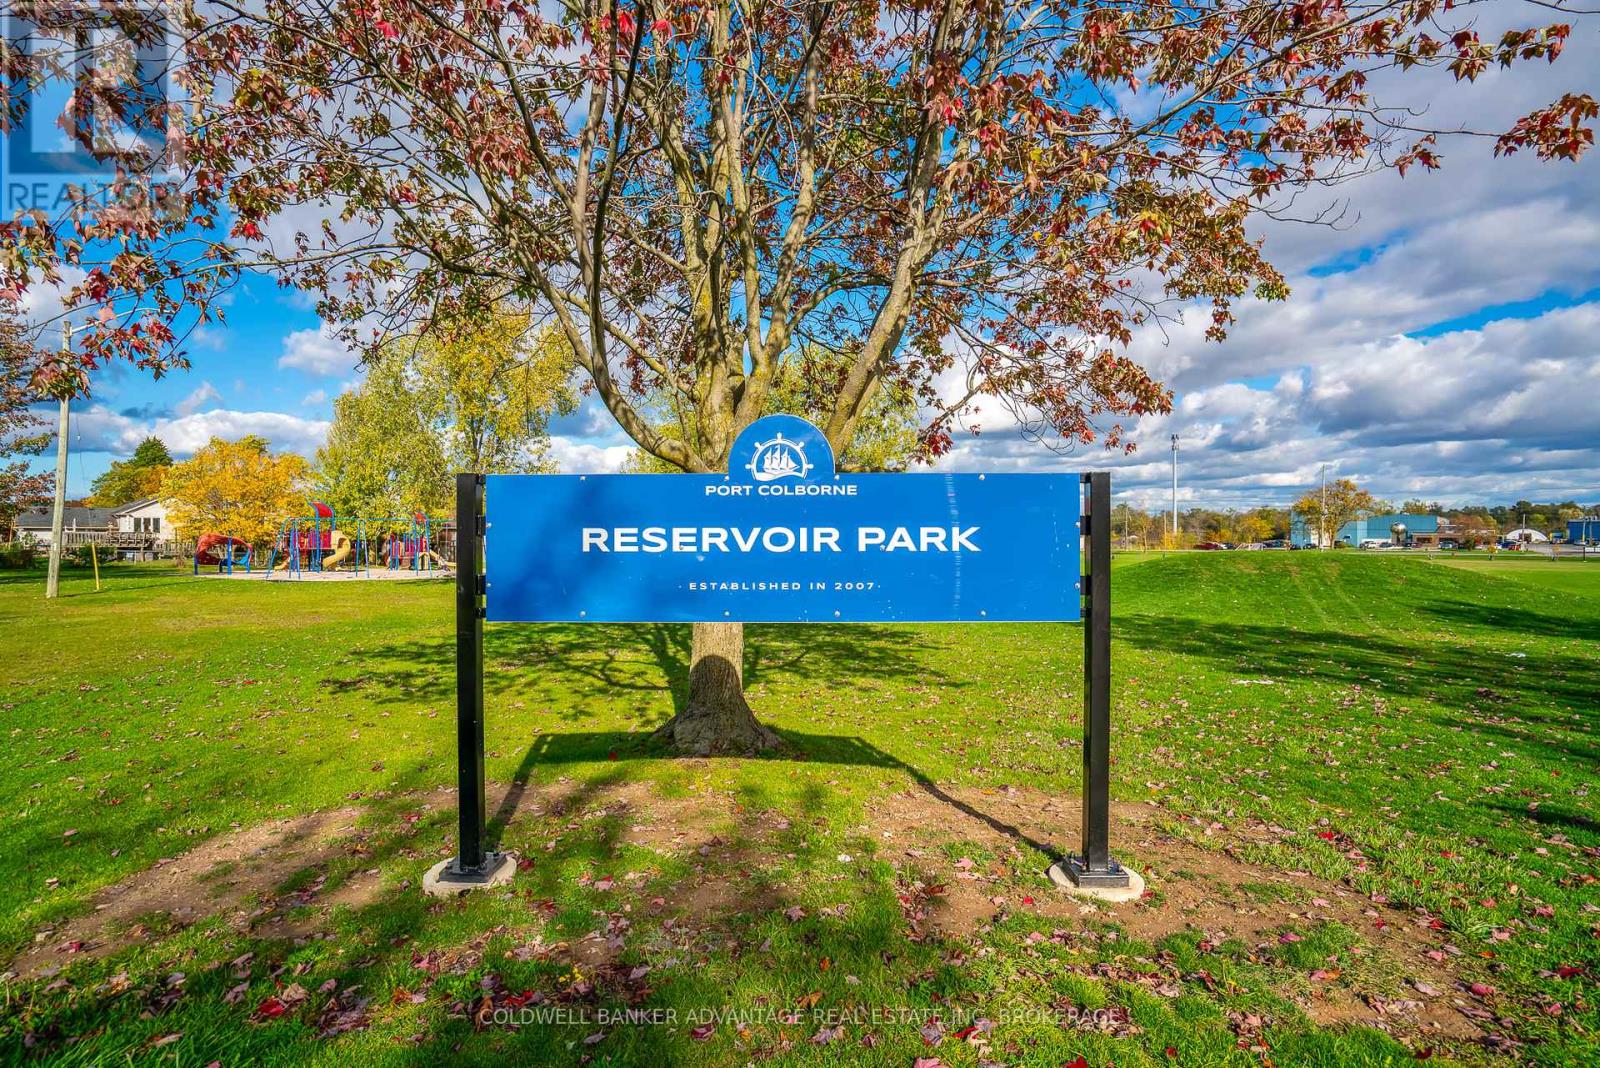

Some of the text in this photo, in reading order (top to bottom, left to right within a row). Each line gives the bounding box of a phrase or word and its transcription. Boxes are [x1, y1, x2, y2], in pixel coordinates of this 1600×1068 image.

[704, 484, 858, 496] PORT COLBORNE
[580, 526, 981, 553] RESERVOIR PARK
[688, 581, 875, 591] ESTABLISHED IN 2007
